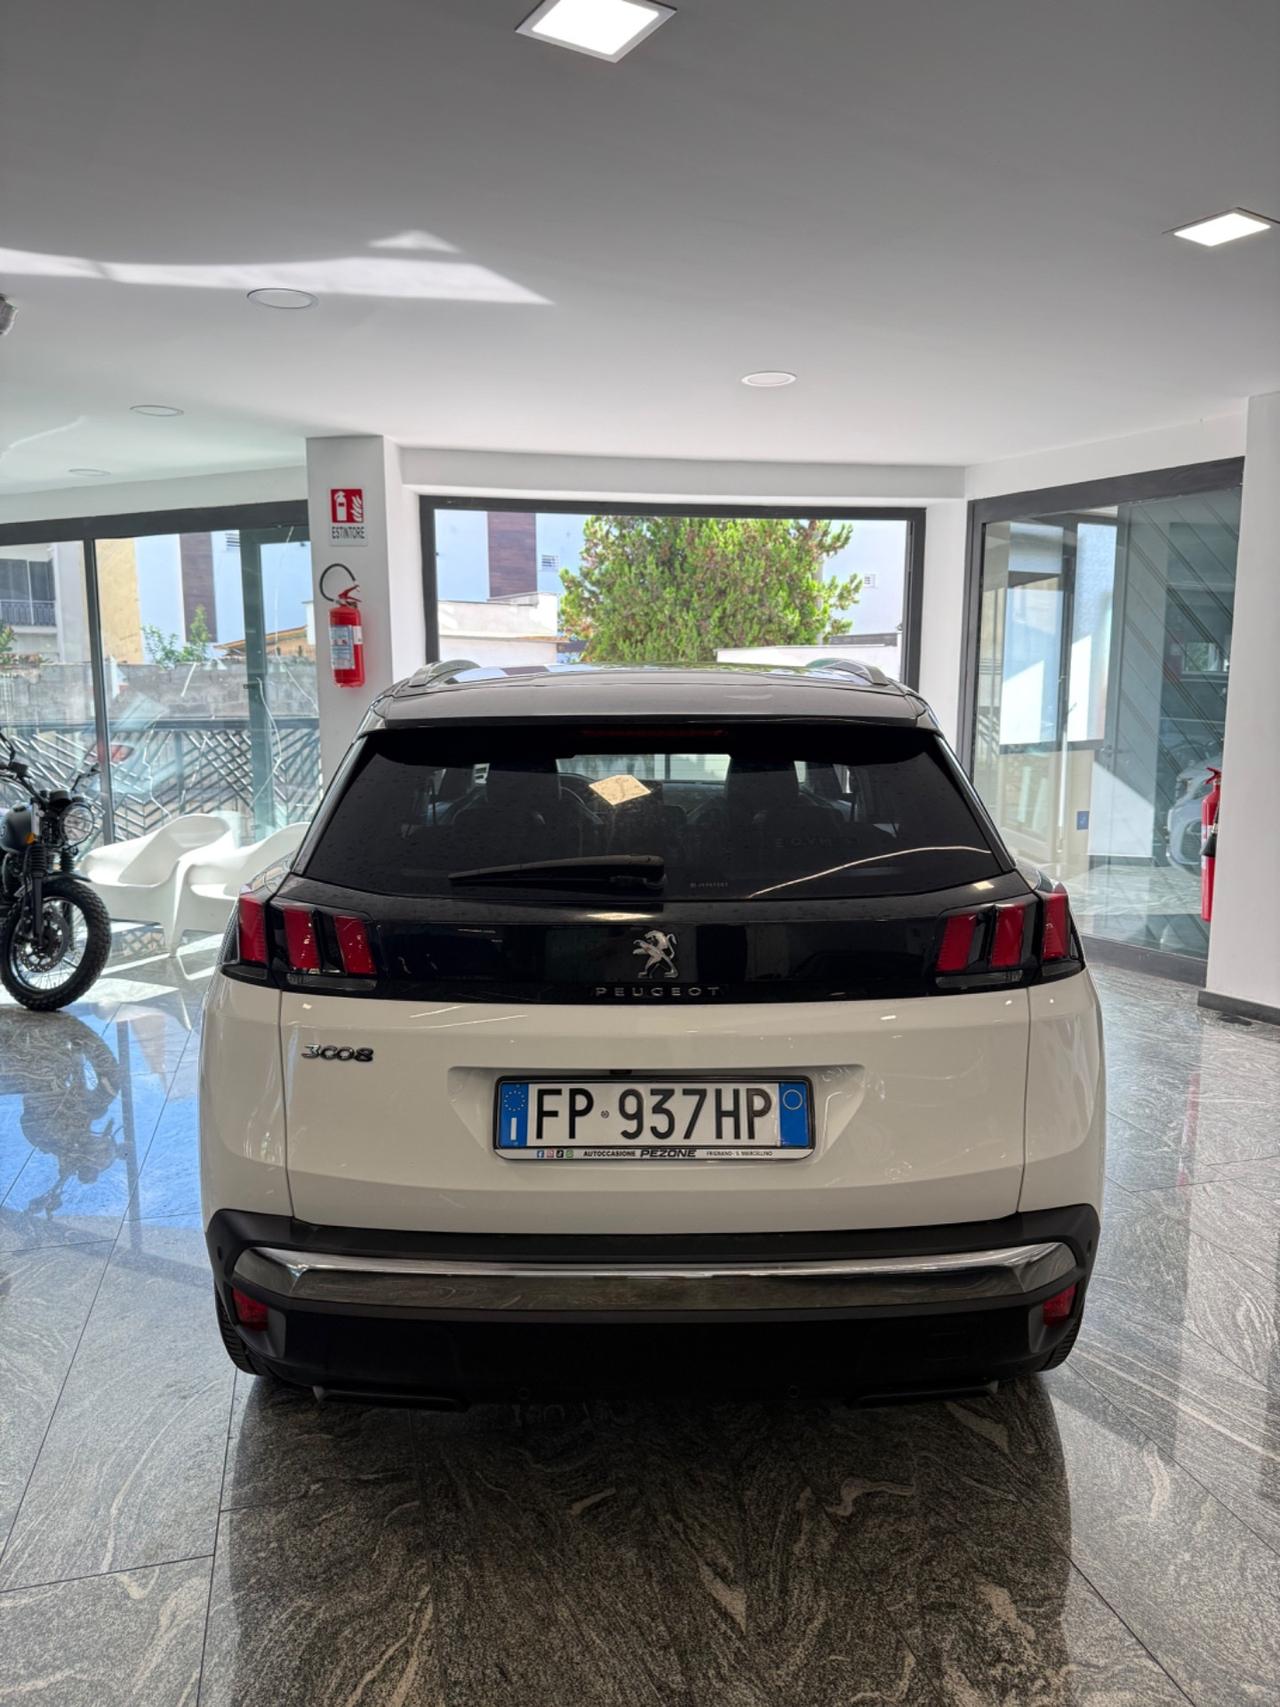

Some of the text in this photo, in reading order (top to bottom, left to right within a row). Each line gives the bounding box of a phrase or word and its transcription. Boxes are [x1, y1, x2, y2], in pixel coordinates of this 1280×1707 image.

[331, 526, 365, 539] ESTINTORE
[595, 987, 720, 997] PEUGEOT
[301, 1044, 374, 1062] 3008
[536, 1087, 772, 1140] FP 937HP
[640, 1149, 697, 1158] PEZONE
